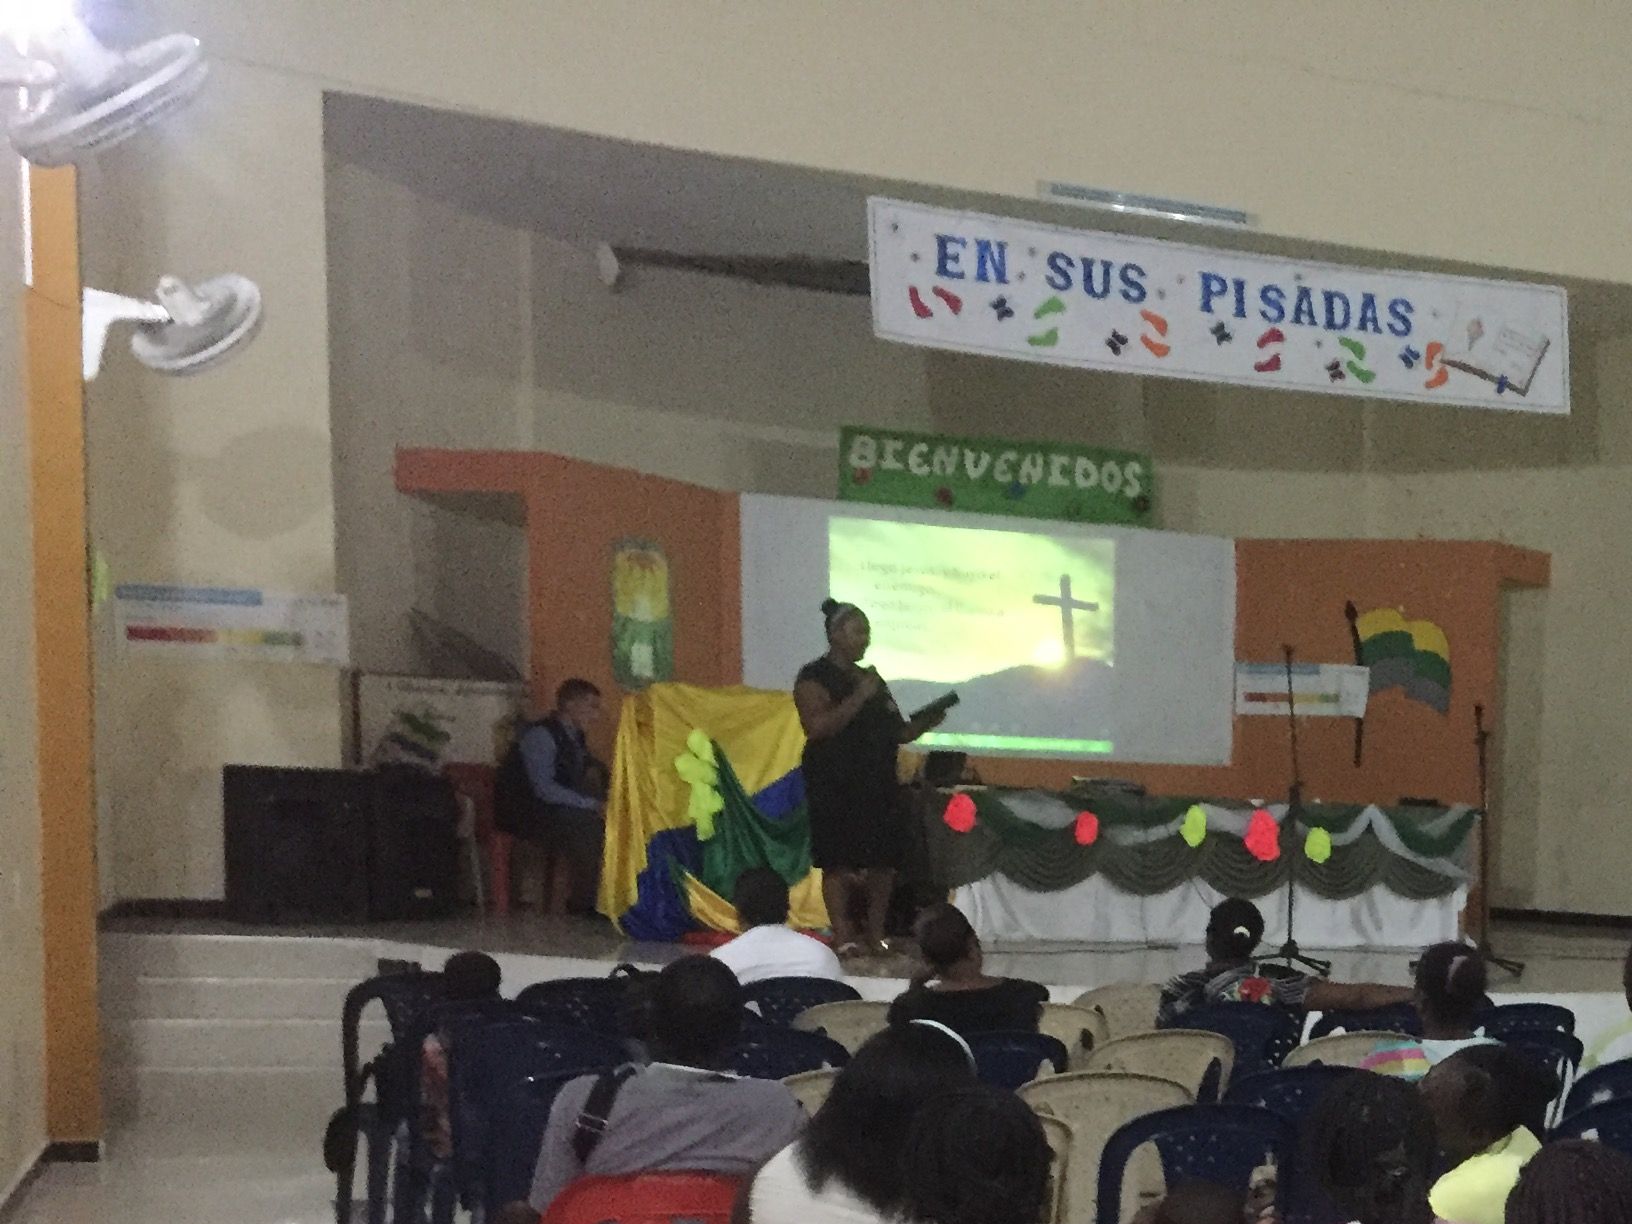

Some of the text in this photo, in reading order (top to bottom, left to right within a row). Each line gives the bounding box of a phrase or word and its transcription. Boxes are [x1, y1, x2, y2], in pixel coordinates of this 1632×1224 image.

[934, 233, 1415, 337] EN SUS PISADAS
[849, 434, 1143, 498] BIENVENIDOS
